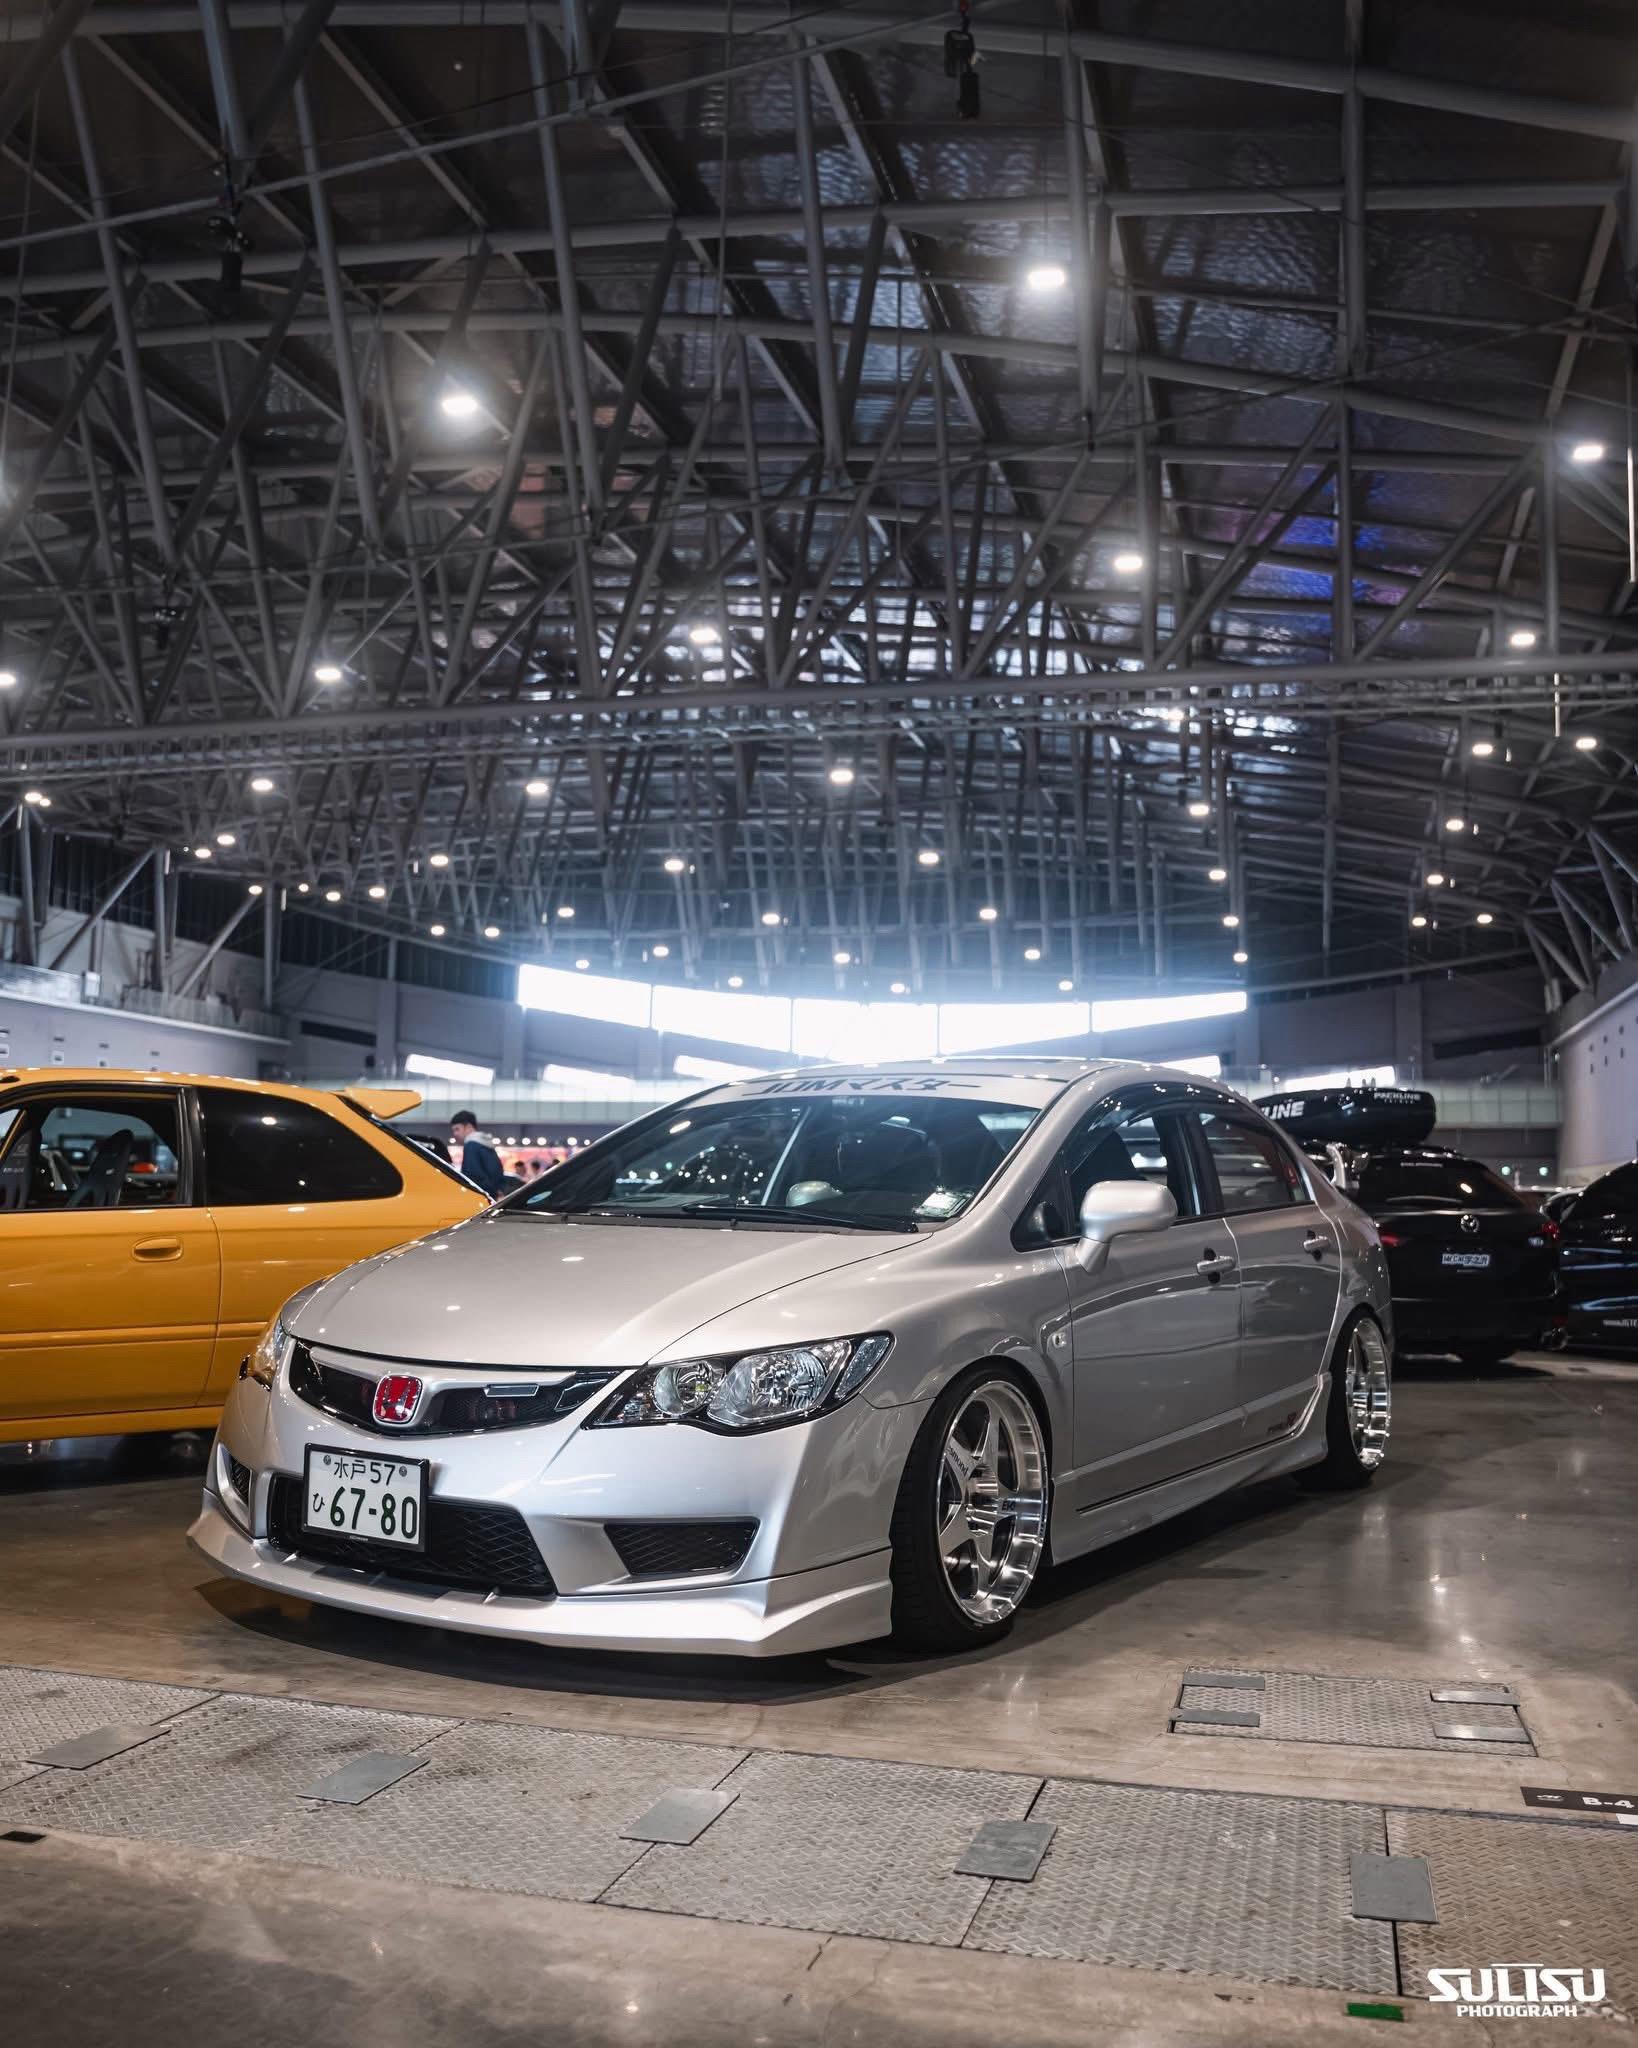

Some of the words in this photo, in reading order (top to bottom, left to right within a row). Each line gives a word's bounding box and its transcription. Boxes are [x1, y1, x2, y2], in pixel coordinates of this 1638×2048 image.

[1261, 1101, 1305, 1119] LINE
[312, 1493, 325, 1513] ひ
[330, 1486, 418, 1539] 67-80
